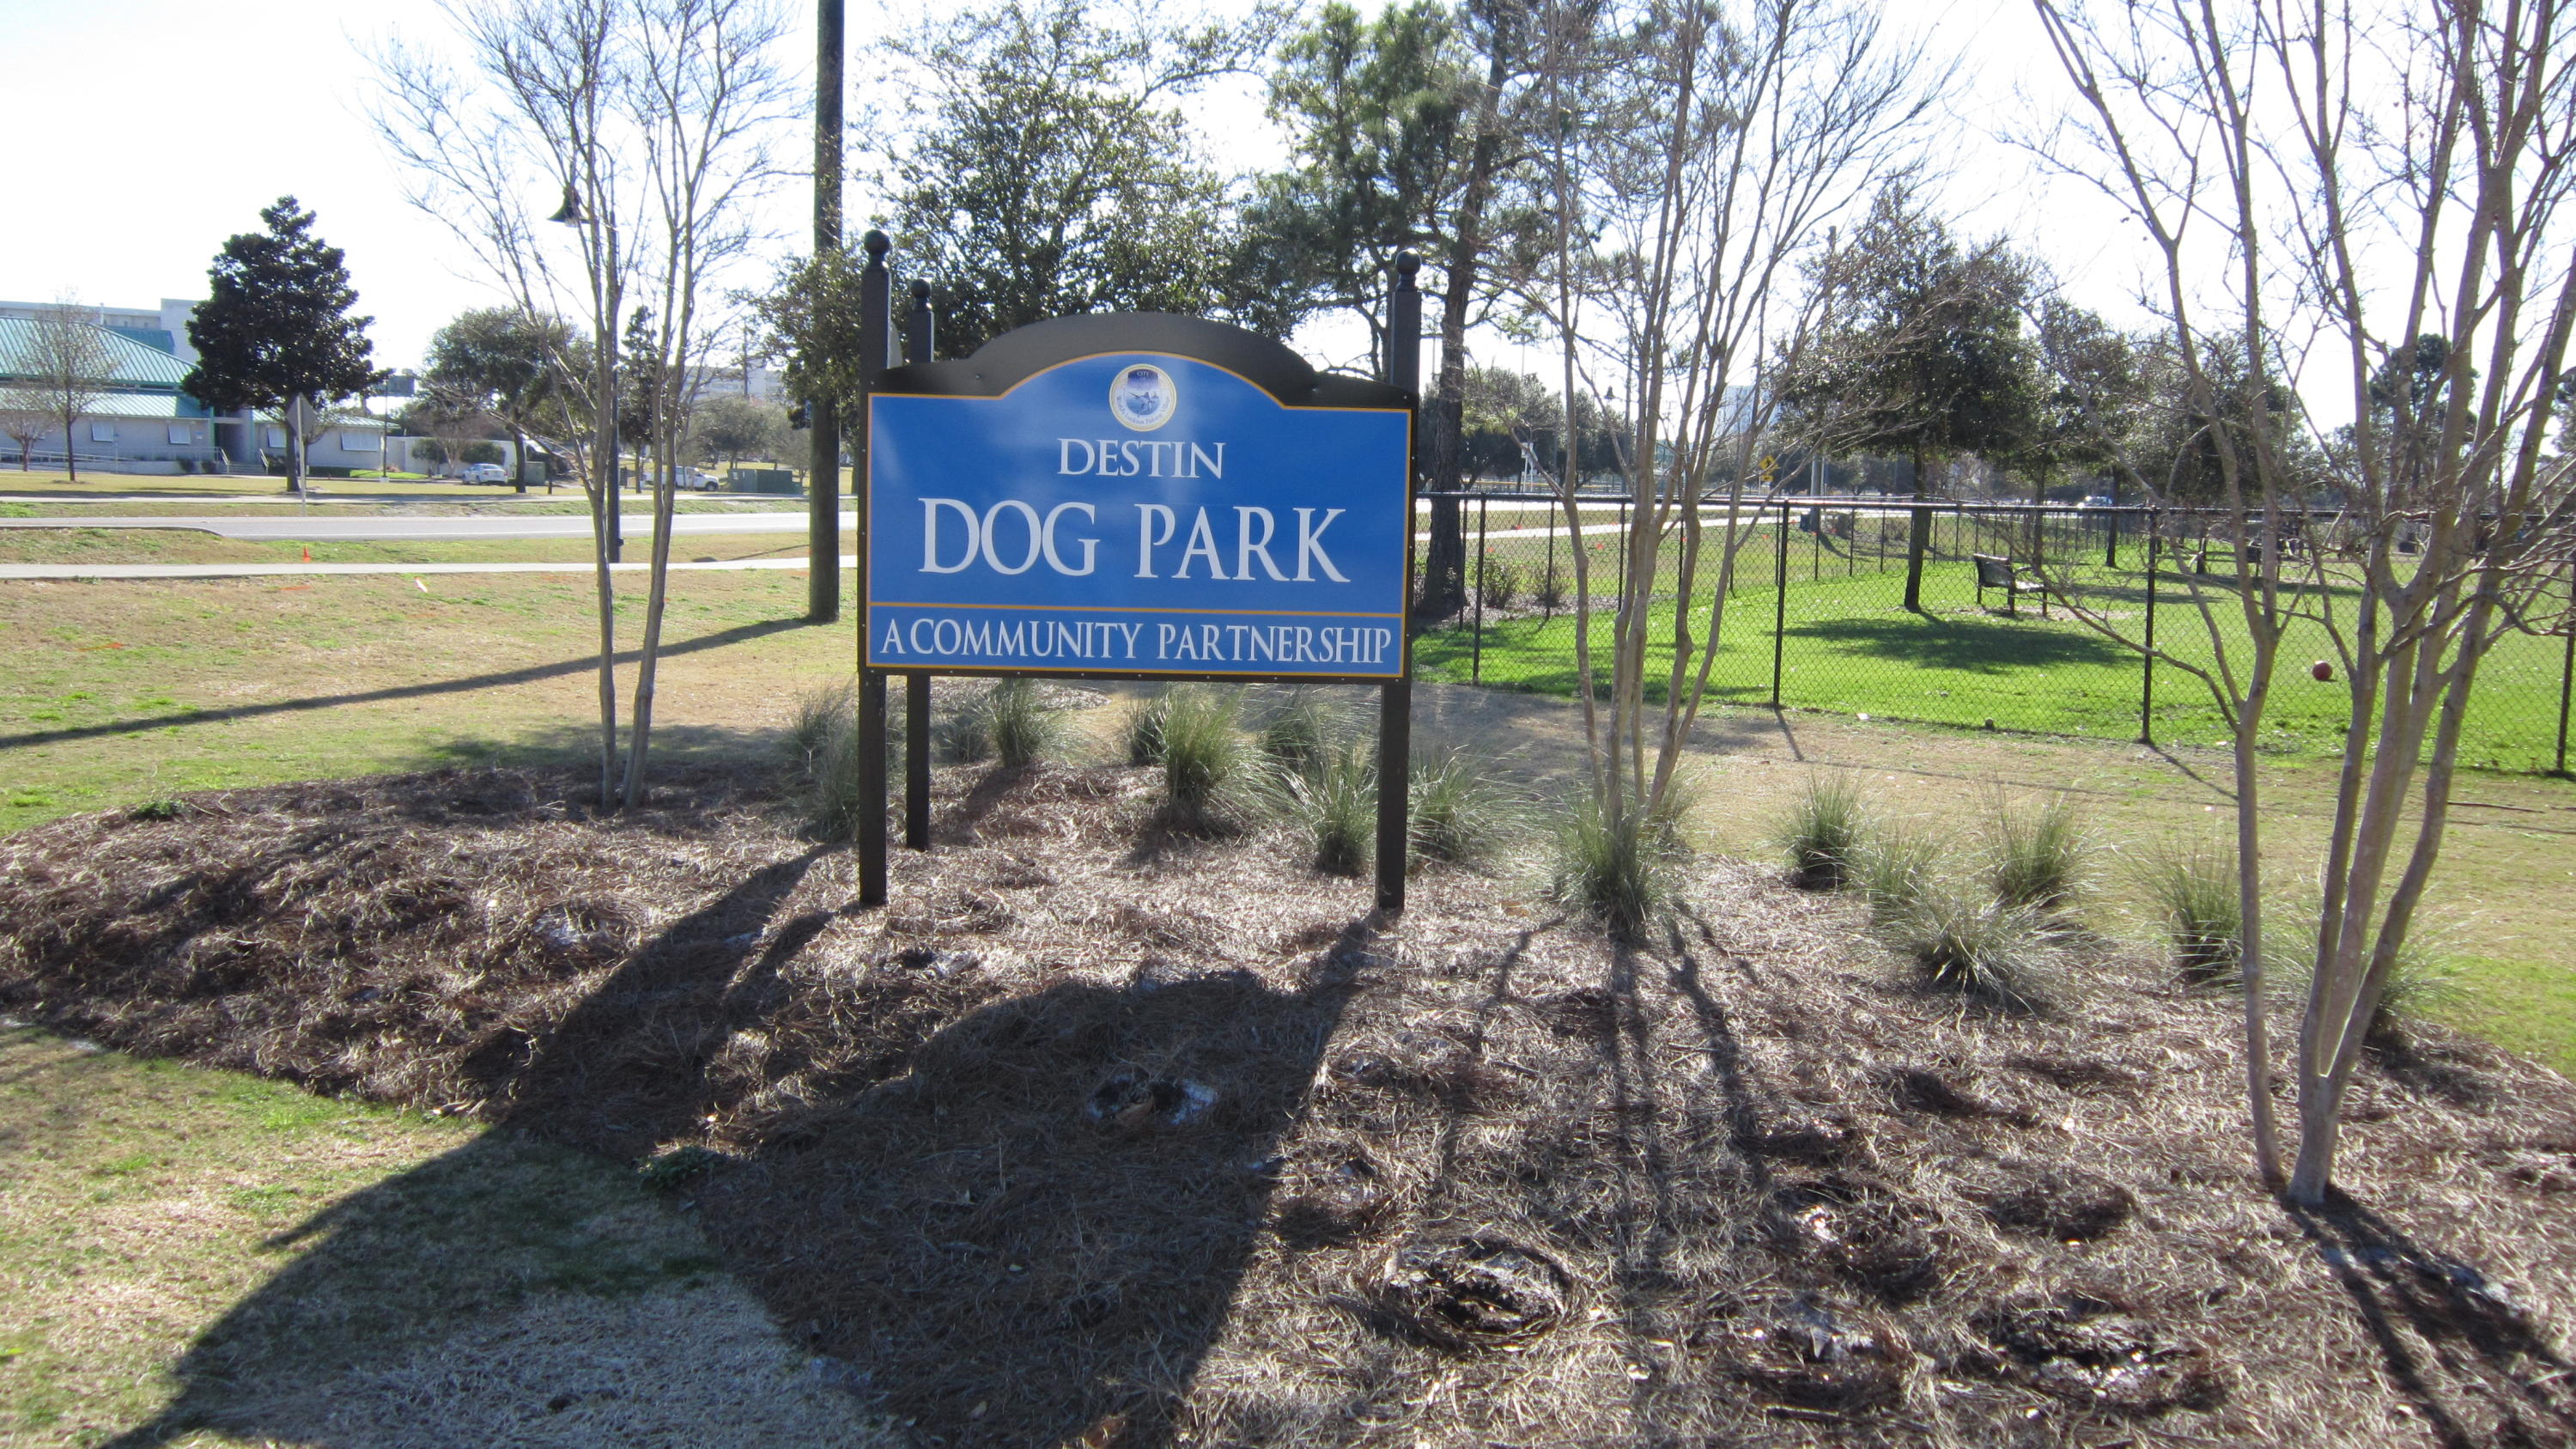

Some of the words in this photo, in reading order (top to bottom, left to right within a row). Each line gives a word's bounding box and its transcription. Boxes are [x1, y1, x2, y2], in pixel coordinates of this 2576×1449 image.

[1057, 438, 1225, 479] DESTIN
[919, 498, 1100, 576] DOG
[1134, 503, 1351, 582] PARK
[879, 618, 907, 654] A
[910, 618, 1144, 659] COMMUNITY
[1157, 624, 1391, 663] PARTNERSHIP
